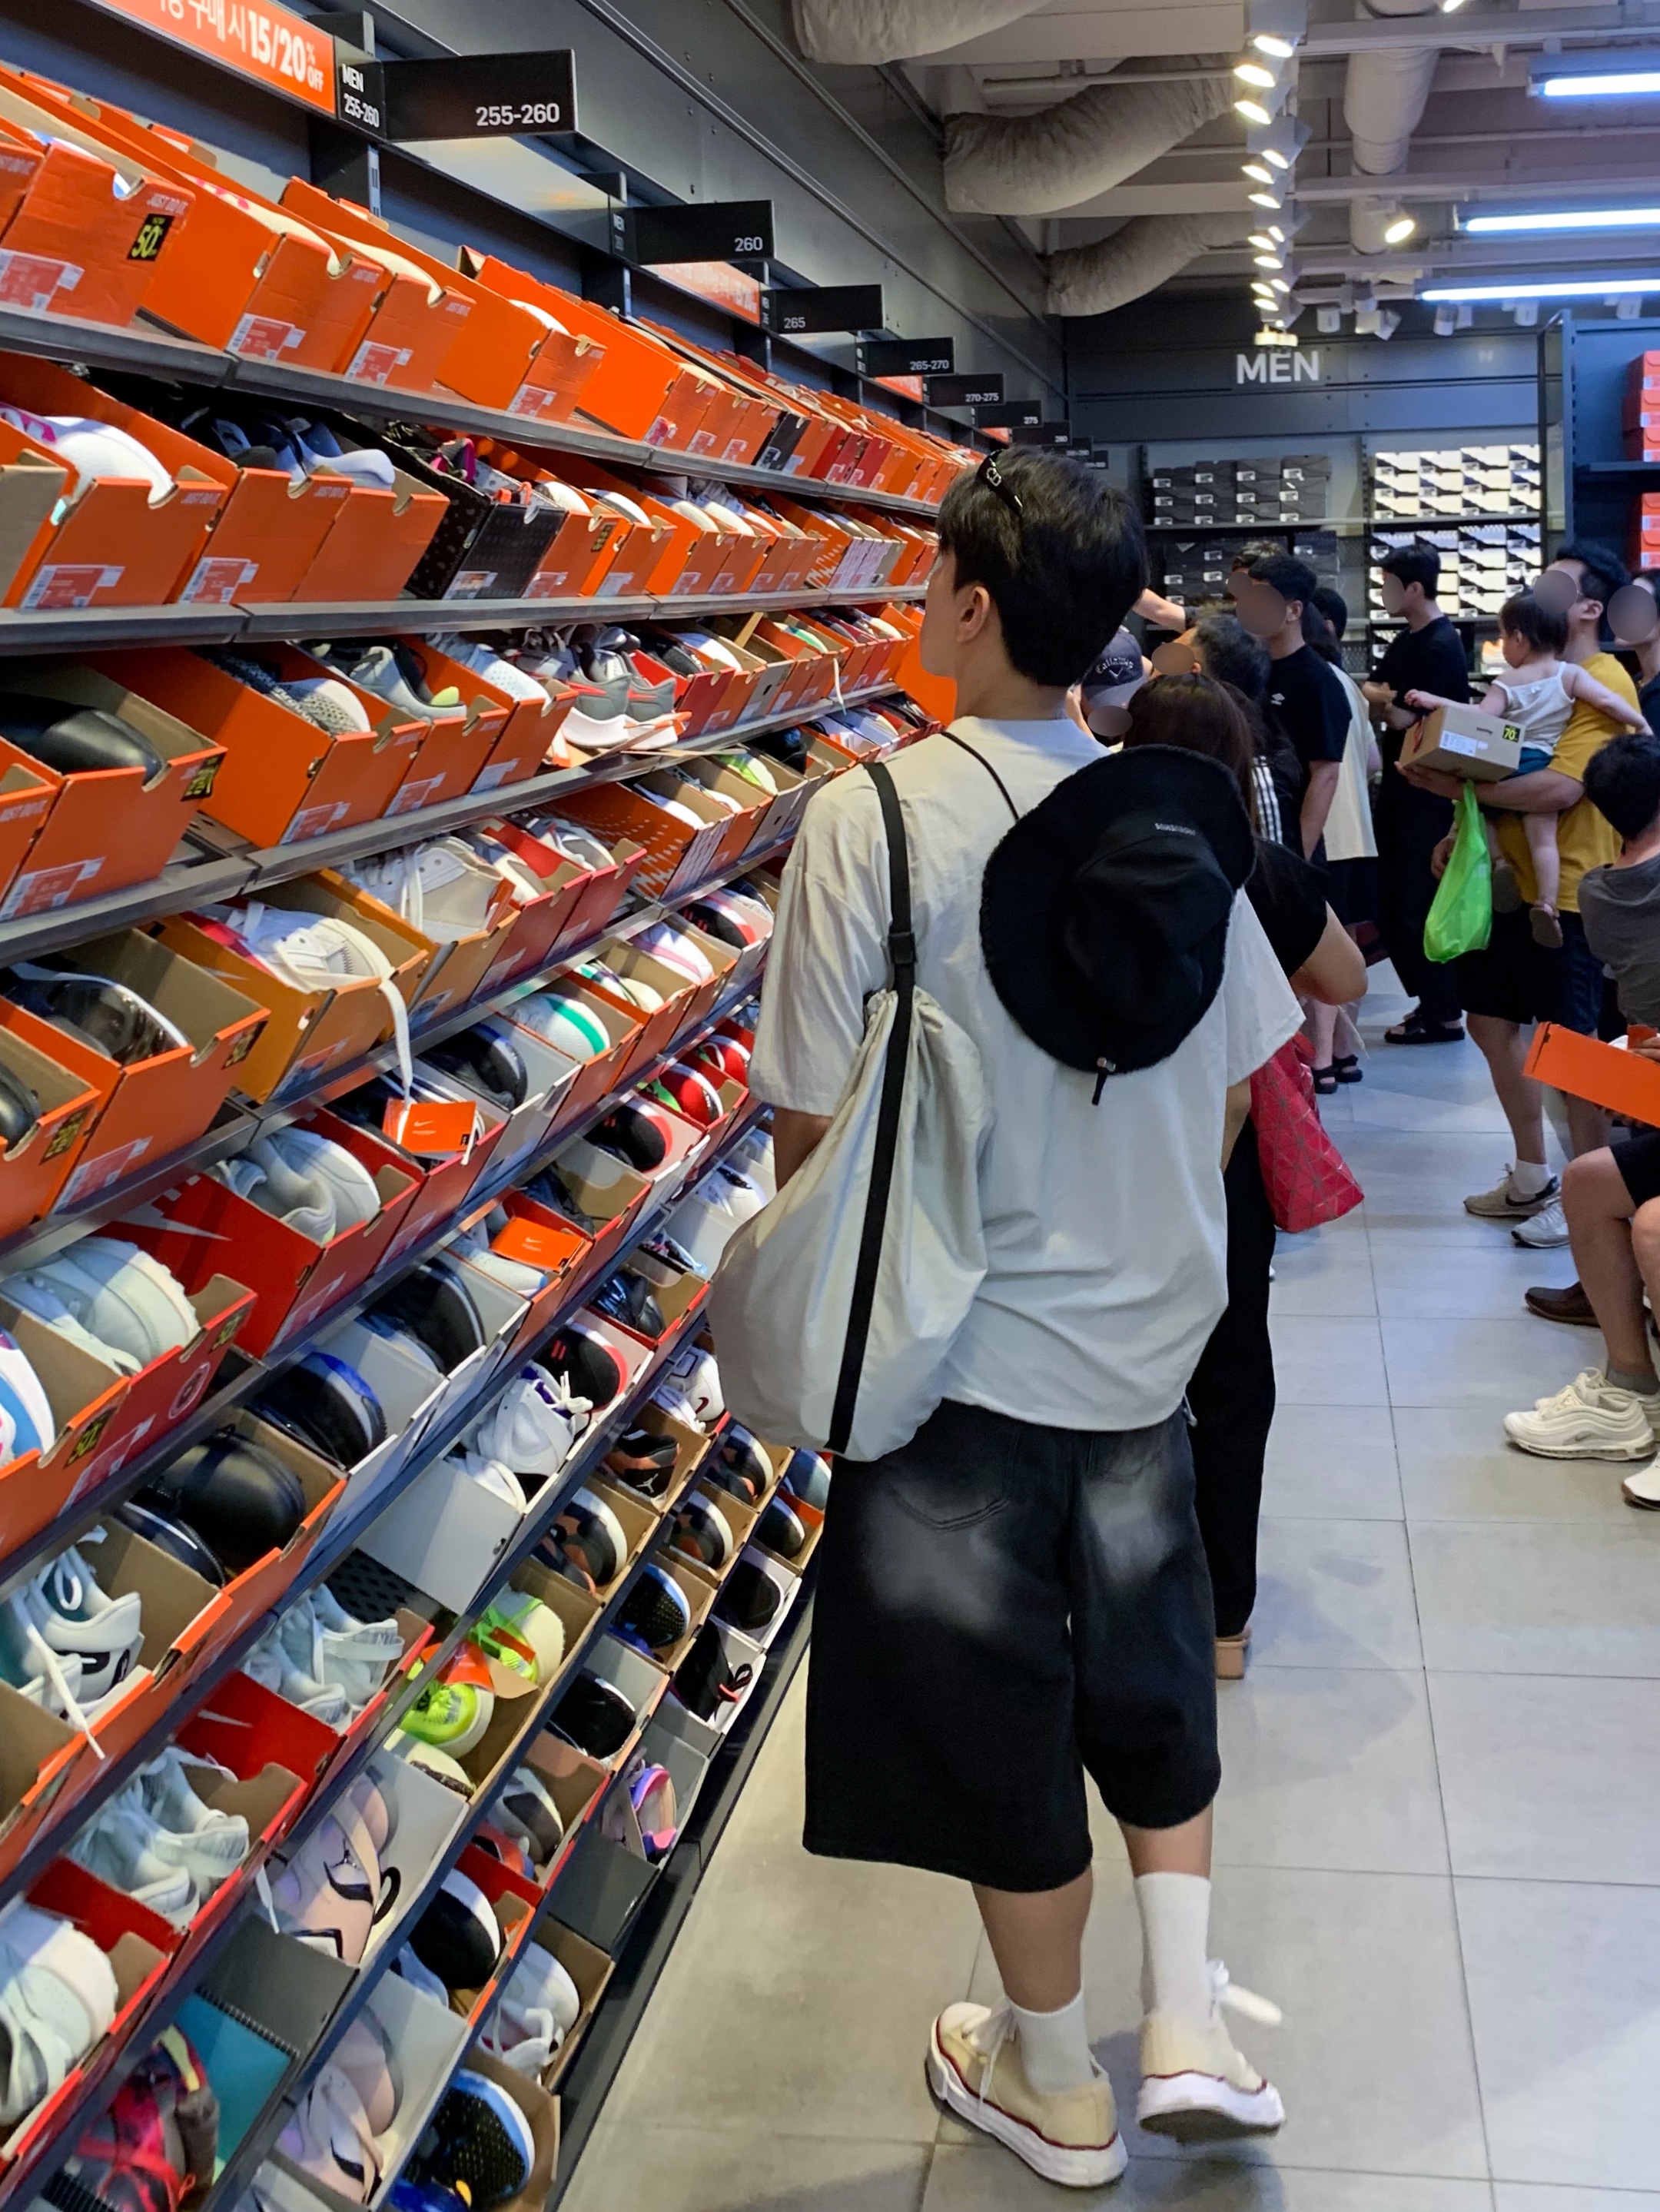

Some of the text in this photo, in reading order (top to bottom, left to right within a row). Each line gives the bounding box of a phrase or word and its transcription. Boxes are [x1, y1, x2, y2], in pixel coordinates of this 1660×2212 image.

[307, 65, 324, 93] OFF
[342, 63, 364, 92] MEN
[344, 93, 380, 128] 255-260
[476, 103, 559, 127] 255-260
[734, 236, 763, 252] 260
[784, 317, 806, 329] 265
[910, 359, 950, 371] 265-270
[1237, 350, 1320, 384] MEN
[965, 392, 999, 402] 270-275
[1024, 416, 1038, 424] 275
